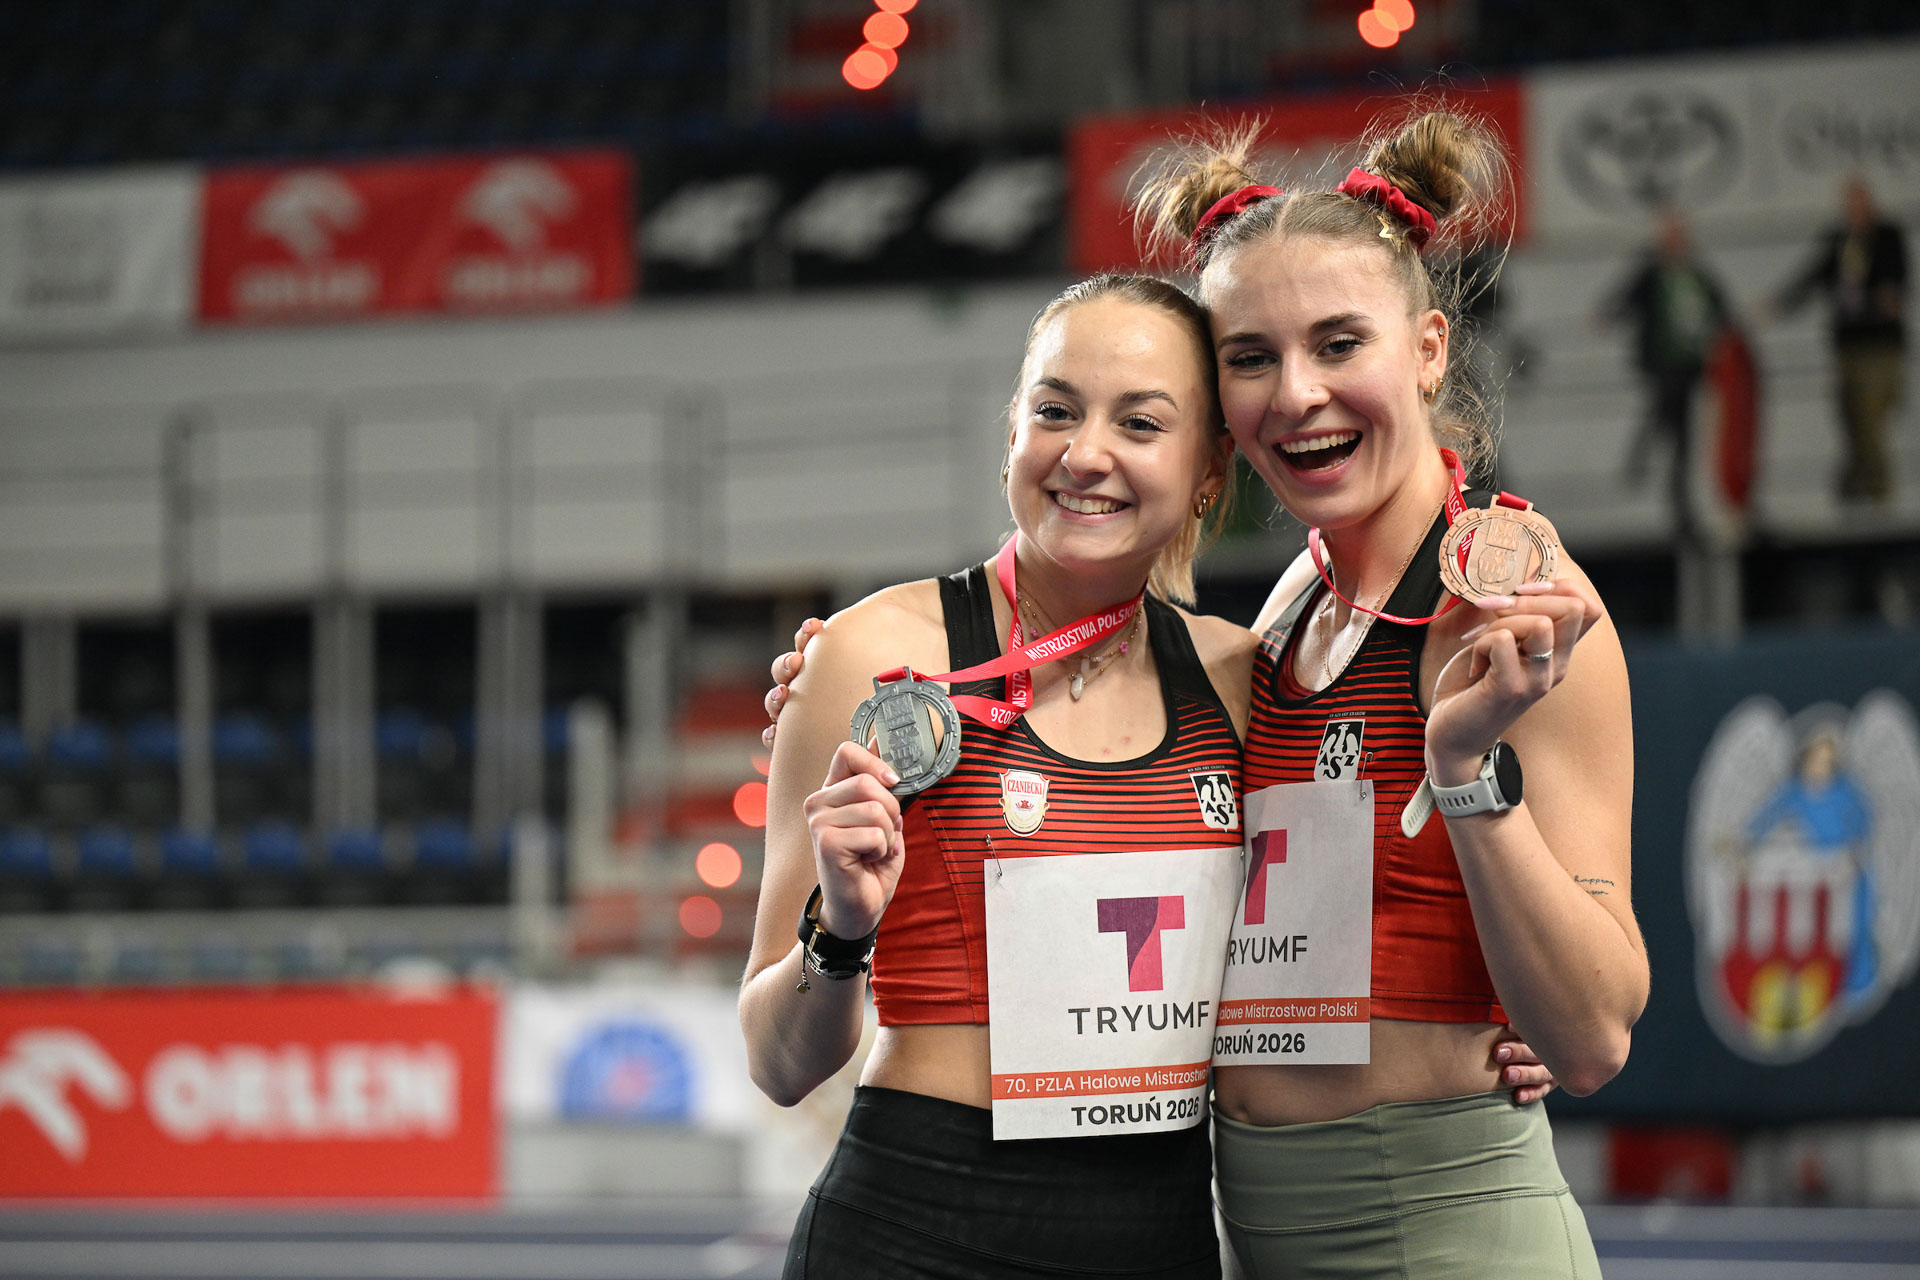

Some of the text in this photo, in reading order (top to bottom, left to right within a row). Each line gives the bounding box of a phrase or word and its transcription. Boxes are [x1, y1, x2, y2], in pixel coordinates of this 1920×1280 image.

[1025, 605, 1135, 662] MISTRZOSTWA POLSKI
[1007, 779, 1043, 795] CZANIECKI
[1227, 936, 1307, 966] RYUMF
[1068, 1000, 1210, 1035] TRYUMF
[1219, 1001, 1358, 1020] alowe Mistrzostwa Polski
[1256, 1032, 1306, 1054] 2026
[144, 1042, 459, 1143] ORLEN
[1004, 1078, 1031, 1094] 70.
[1035, 1077, 1076, 1092] PZLA
[1080, 1073, 1141, 1090] Halowe
[1071, 1095, 1199, 1126] TORUŃ 2026
